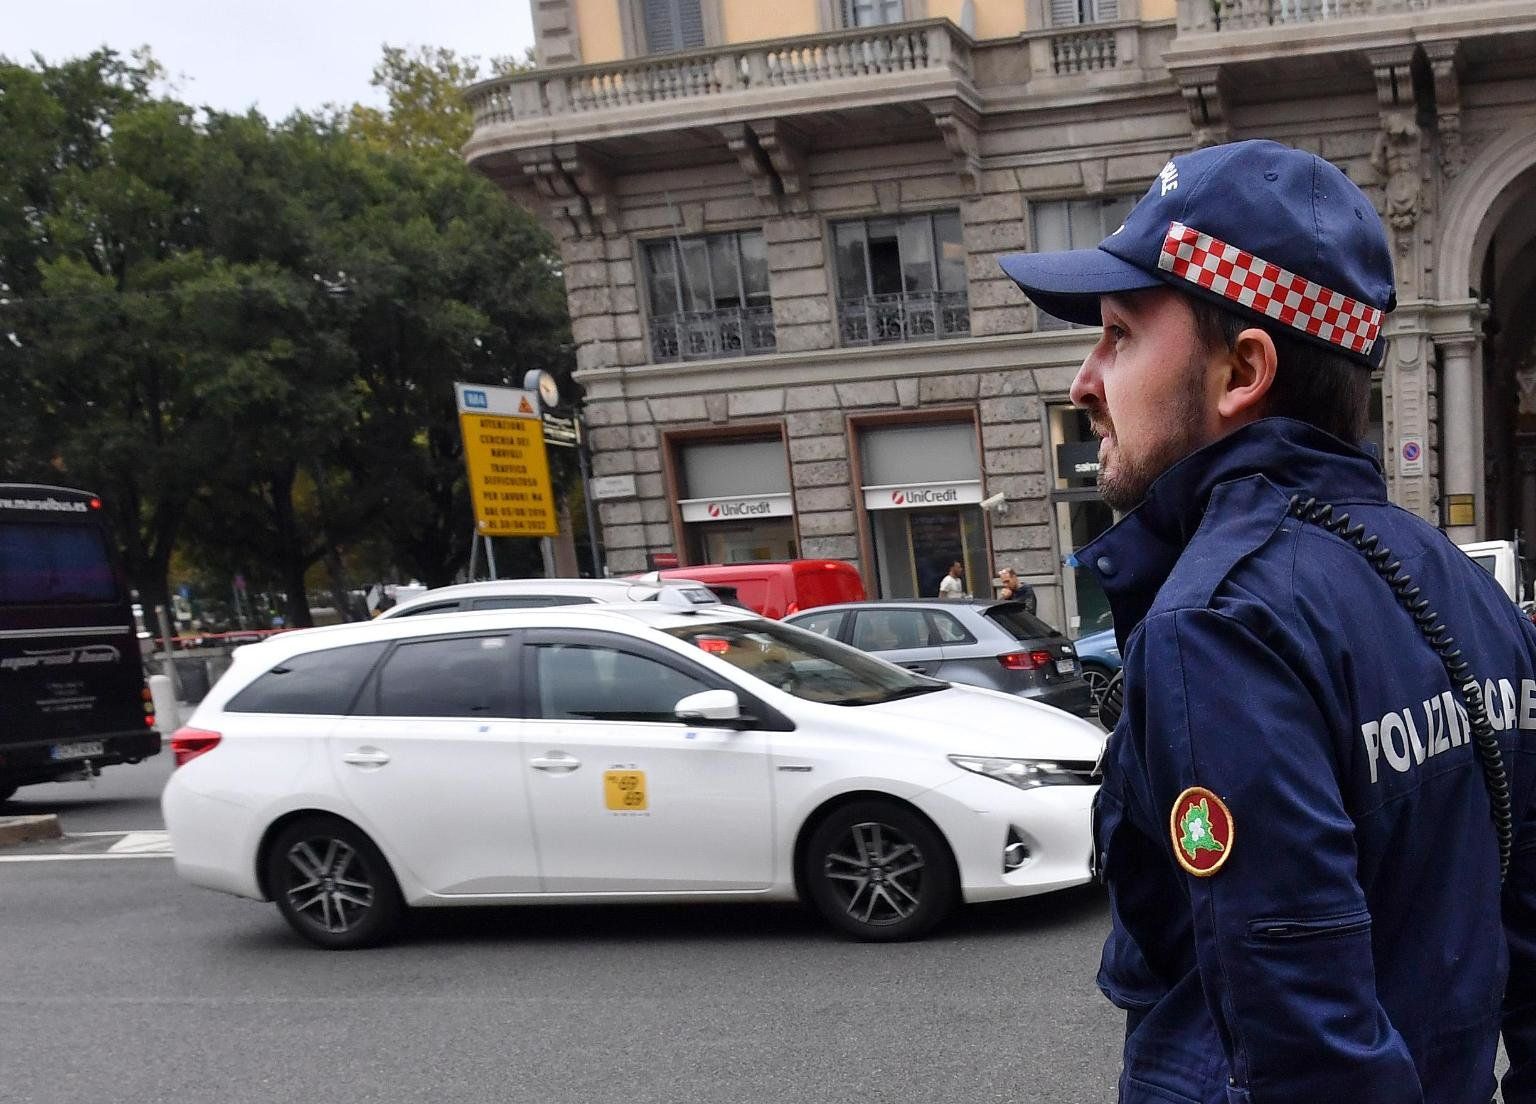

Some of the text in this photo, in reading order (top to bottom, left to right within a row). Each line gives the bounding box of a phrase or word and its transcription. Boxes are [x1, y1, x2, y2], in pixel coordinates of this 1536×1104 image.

[906, 489, 958, 503] UniCredit
[721, 502, 771, 517] UniCredit
[1361, 691, 1471, 784] POLIZIA
